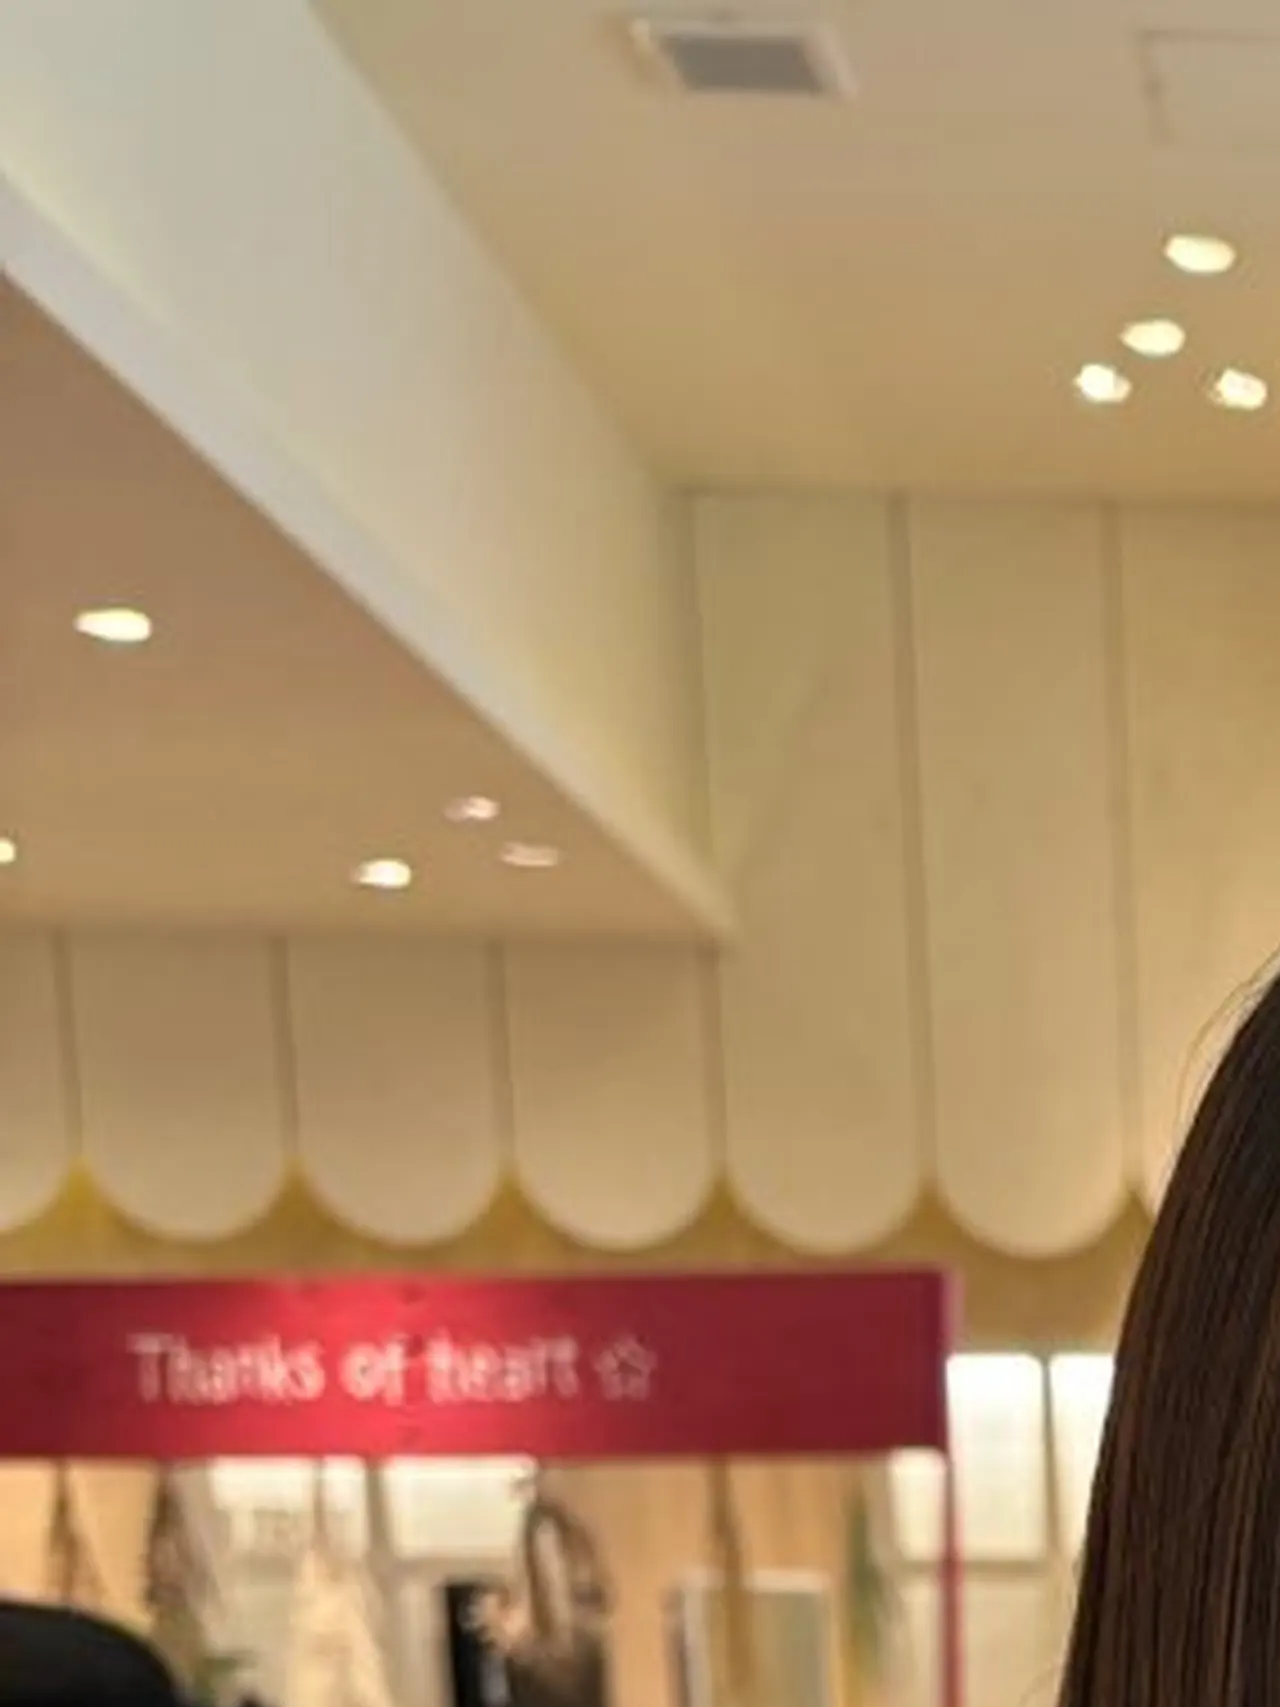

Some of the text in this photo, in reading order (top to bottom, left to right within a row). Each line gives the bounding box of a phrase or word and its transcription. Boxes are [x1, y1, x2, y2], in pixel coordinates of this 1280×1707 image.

[128, 1330, 582, 1407] Thanks of heart
